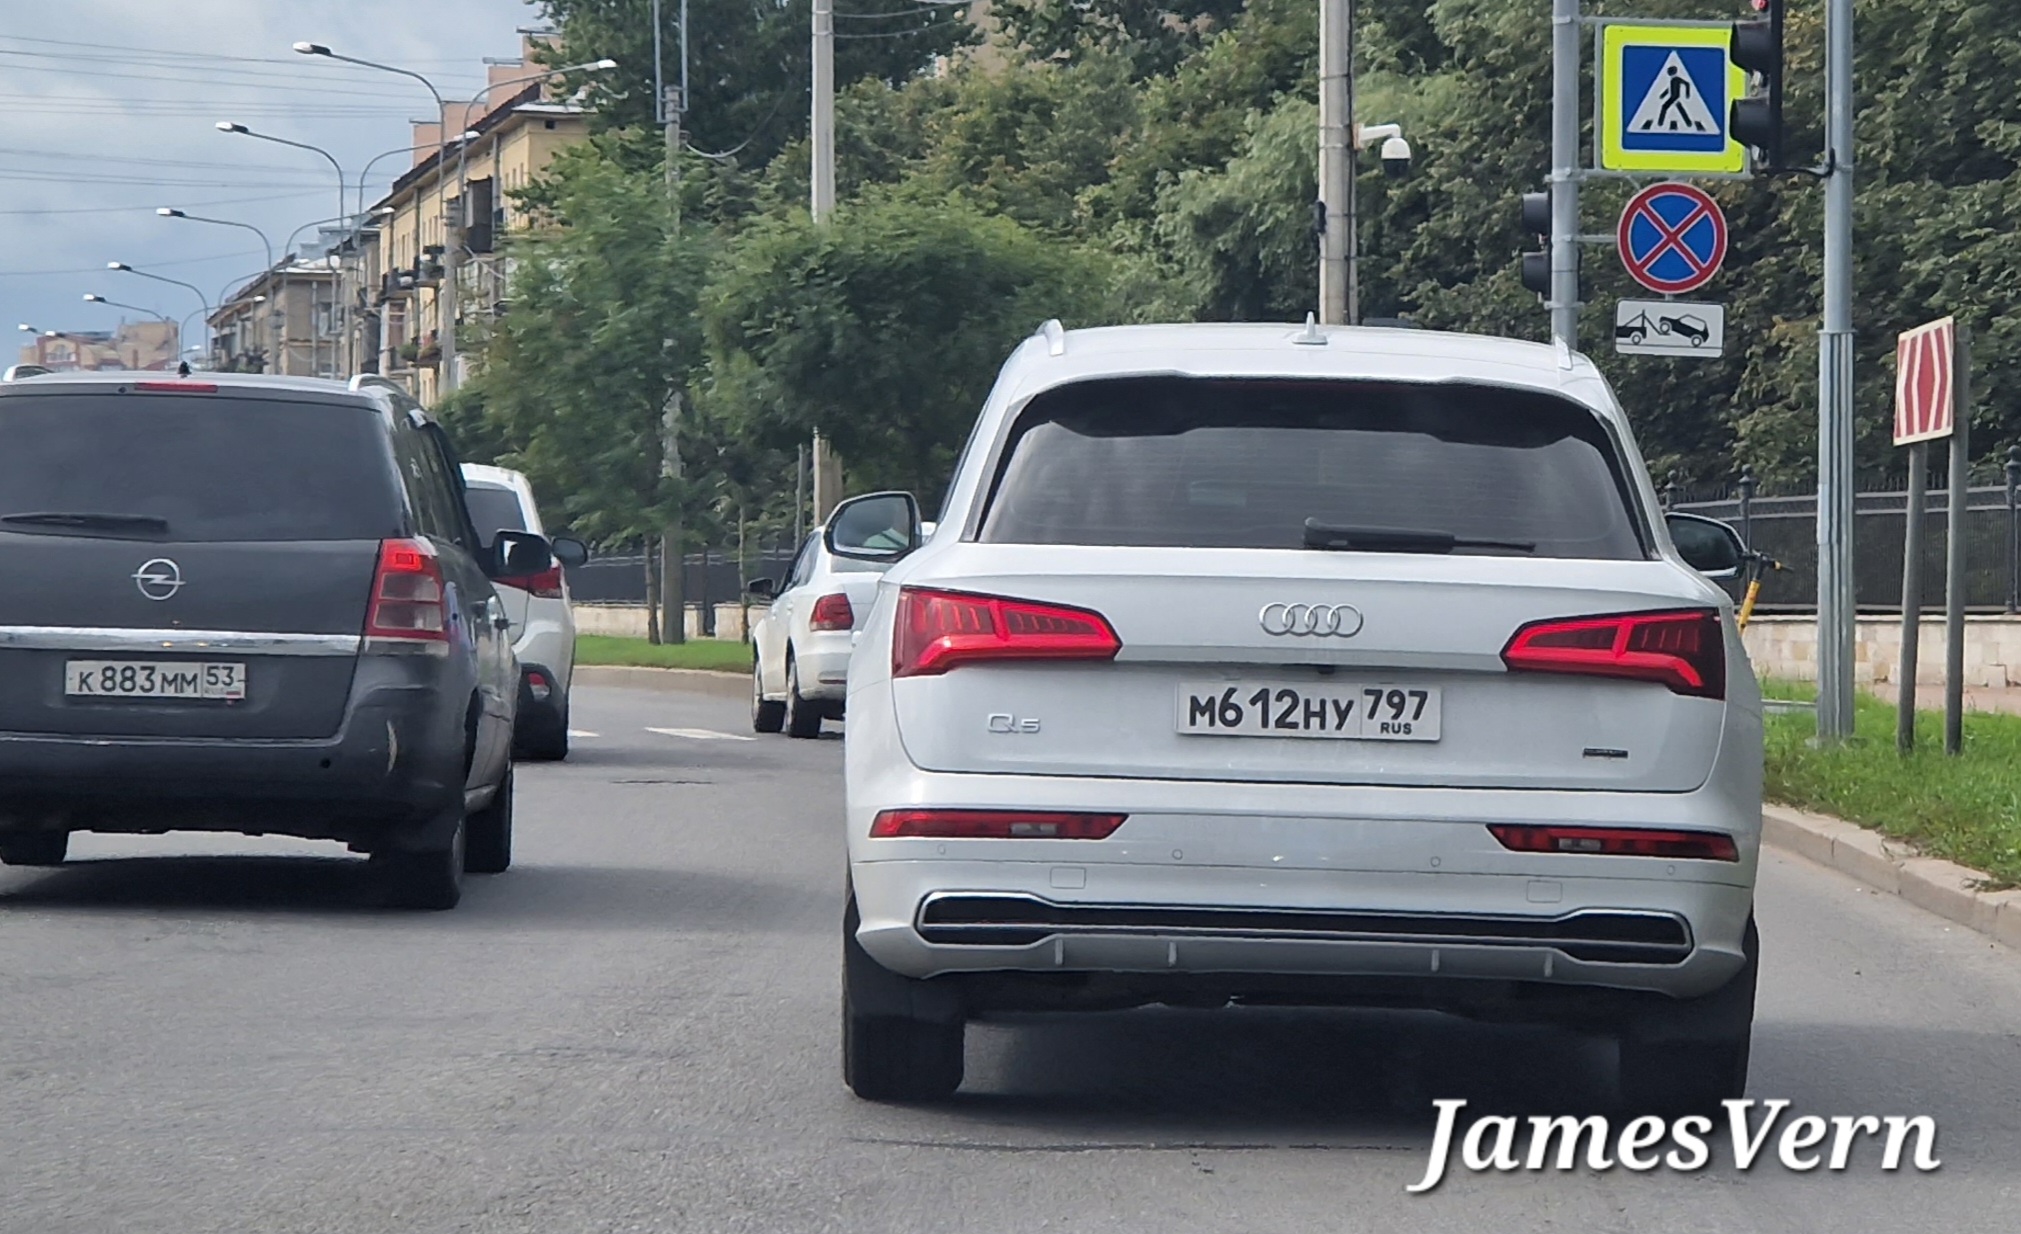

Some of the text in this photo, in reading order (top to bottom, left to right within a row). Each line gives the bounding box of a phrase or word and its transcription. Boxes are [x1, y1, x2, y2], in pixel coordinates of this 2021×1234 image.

[78, 666, 235, 693] К883ММ 53
[1189, 687, 1428, 731] М612НУ 797
[988, 713, 1040, 734] Q5
[1380, 722, 1412, 735] RUS
